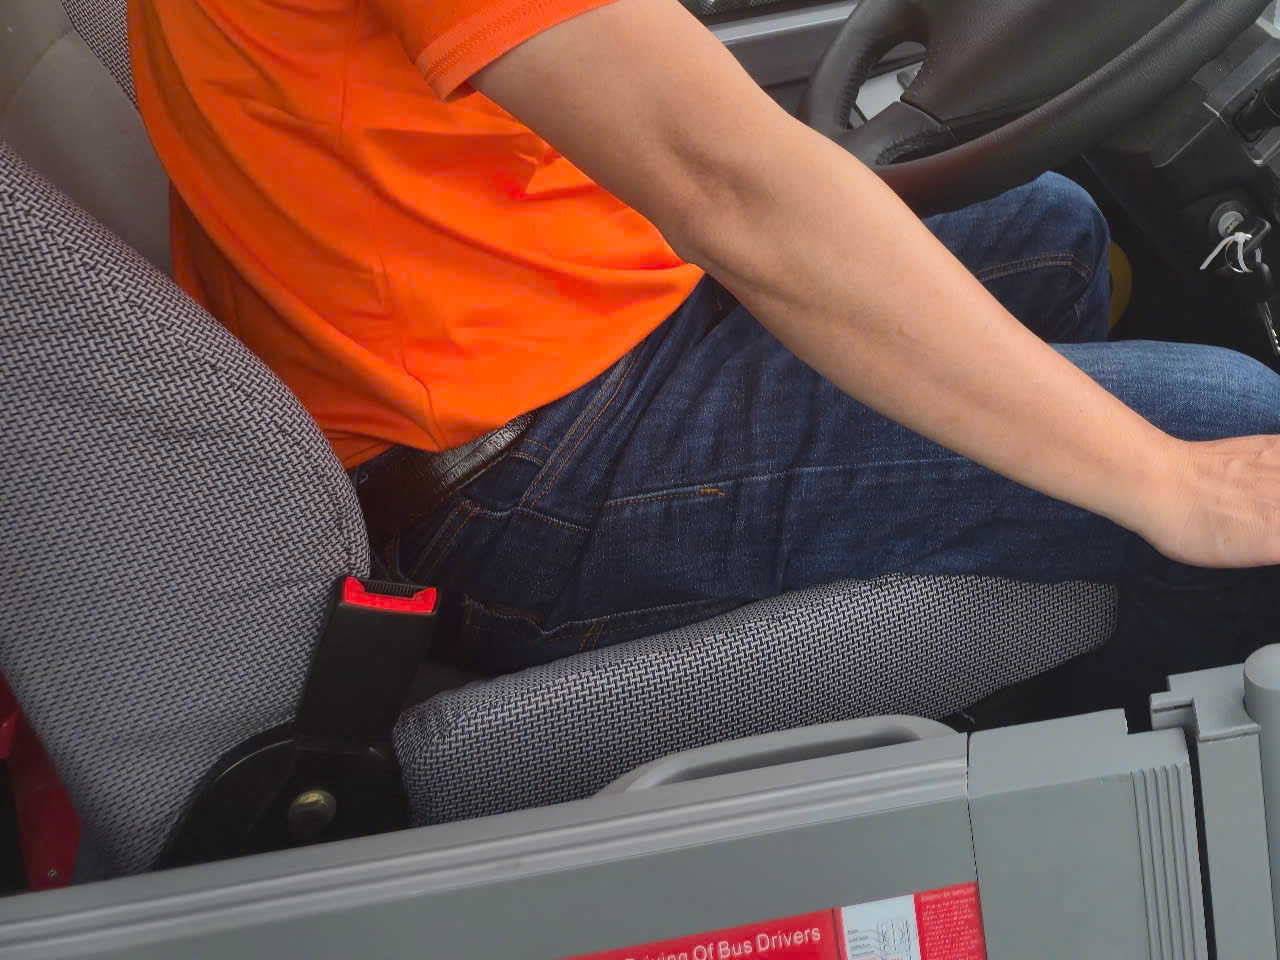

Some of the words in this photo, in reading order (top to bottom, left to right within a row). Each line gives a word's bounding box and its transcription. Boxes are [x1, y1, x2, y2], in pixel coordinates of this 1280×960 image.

[693, 942, 714, 960] Of
[719, 940, 753, 958] Bus
[757, 927, 821, 952] Drivers
